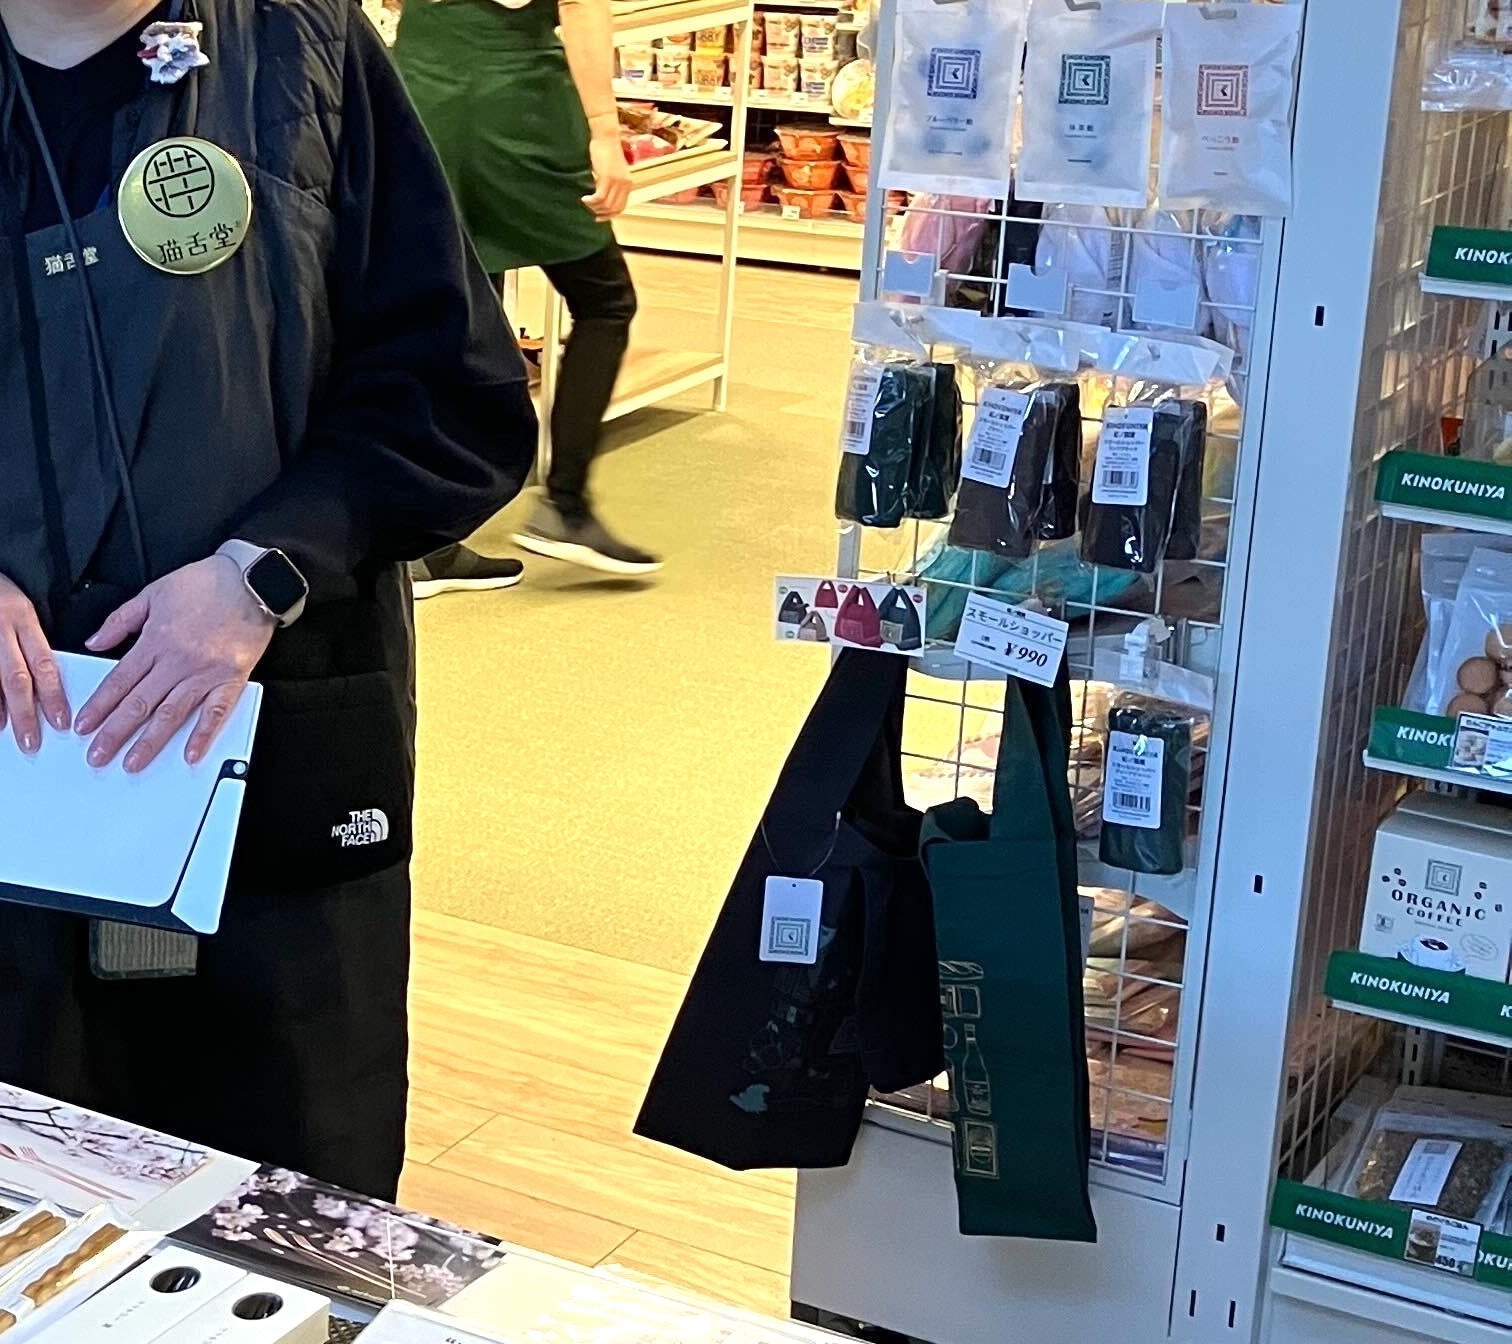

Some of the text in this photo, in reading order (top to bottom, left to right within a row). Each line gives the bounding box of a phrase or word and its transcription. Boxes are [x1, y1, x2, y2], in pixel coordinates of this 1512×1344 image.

[157, 223, 237, 265] 猫舌堂
[1455, 247, 1512, 265] KINOK
[1401, 472, 1505, 500] KINOKUNIYA
[967, 607, 1063, 643] スモールショッパー
[331, 821, 372, 839] NORTH
[349, 809, 372, 823] THE
[341, 832, 372, 848] FACE
[1391, 888, 1487, 921] ORGANIC
[1406, 906, 1464, 928] COFFEE
[1350, 971, 1451, 1005] KINOKUNIYA
[1295, 1203, 1394, 1240] KINOKUNIYA
